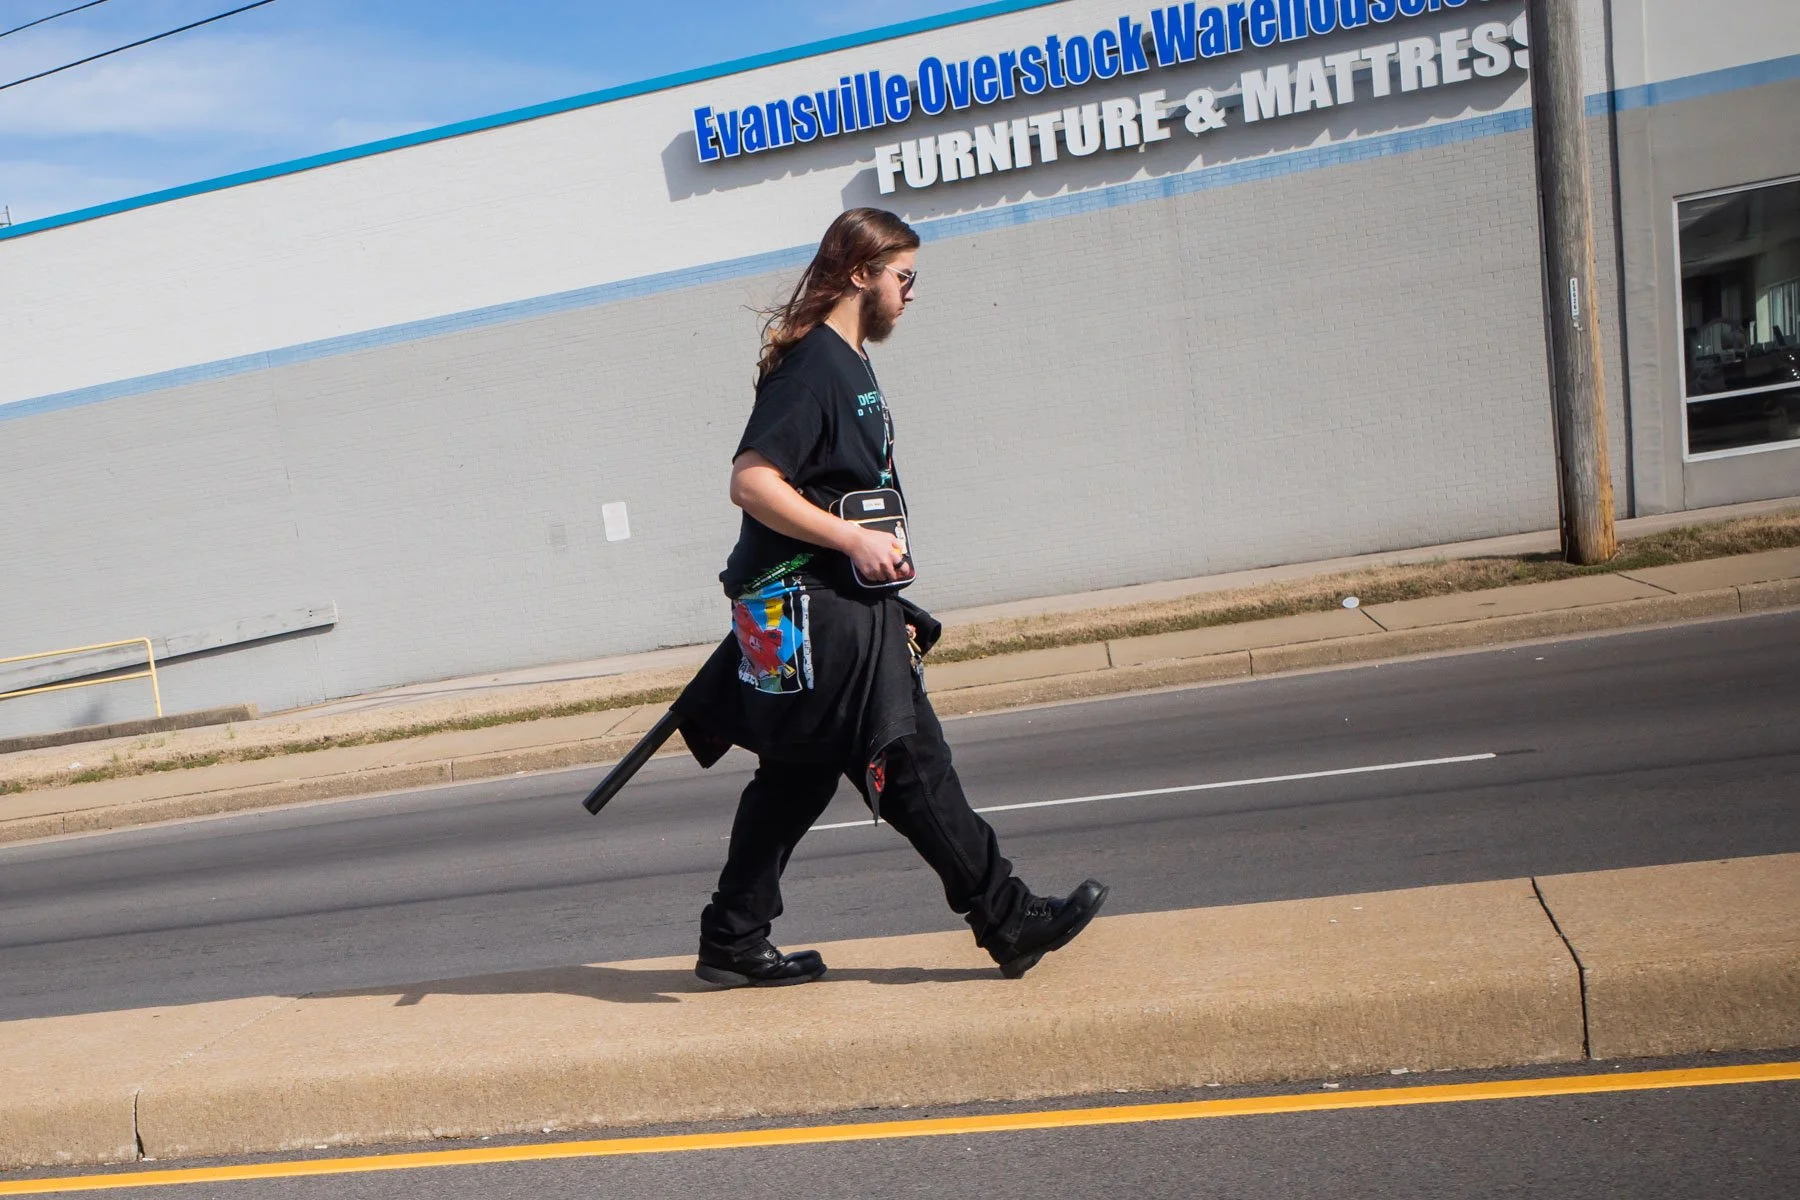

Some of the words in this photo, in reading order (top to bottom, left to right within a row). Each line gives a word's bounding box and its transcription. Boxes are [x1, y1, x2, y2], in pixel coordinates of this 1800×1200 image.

[693, 70, 911, 163] Evansville
[918, 15, 1150, 116] Overstock
[874, 88, 1172, 195] FURNITURE
[1184, 88, 1227, 137] &
